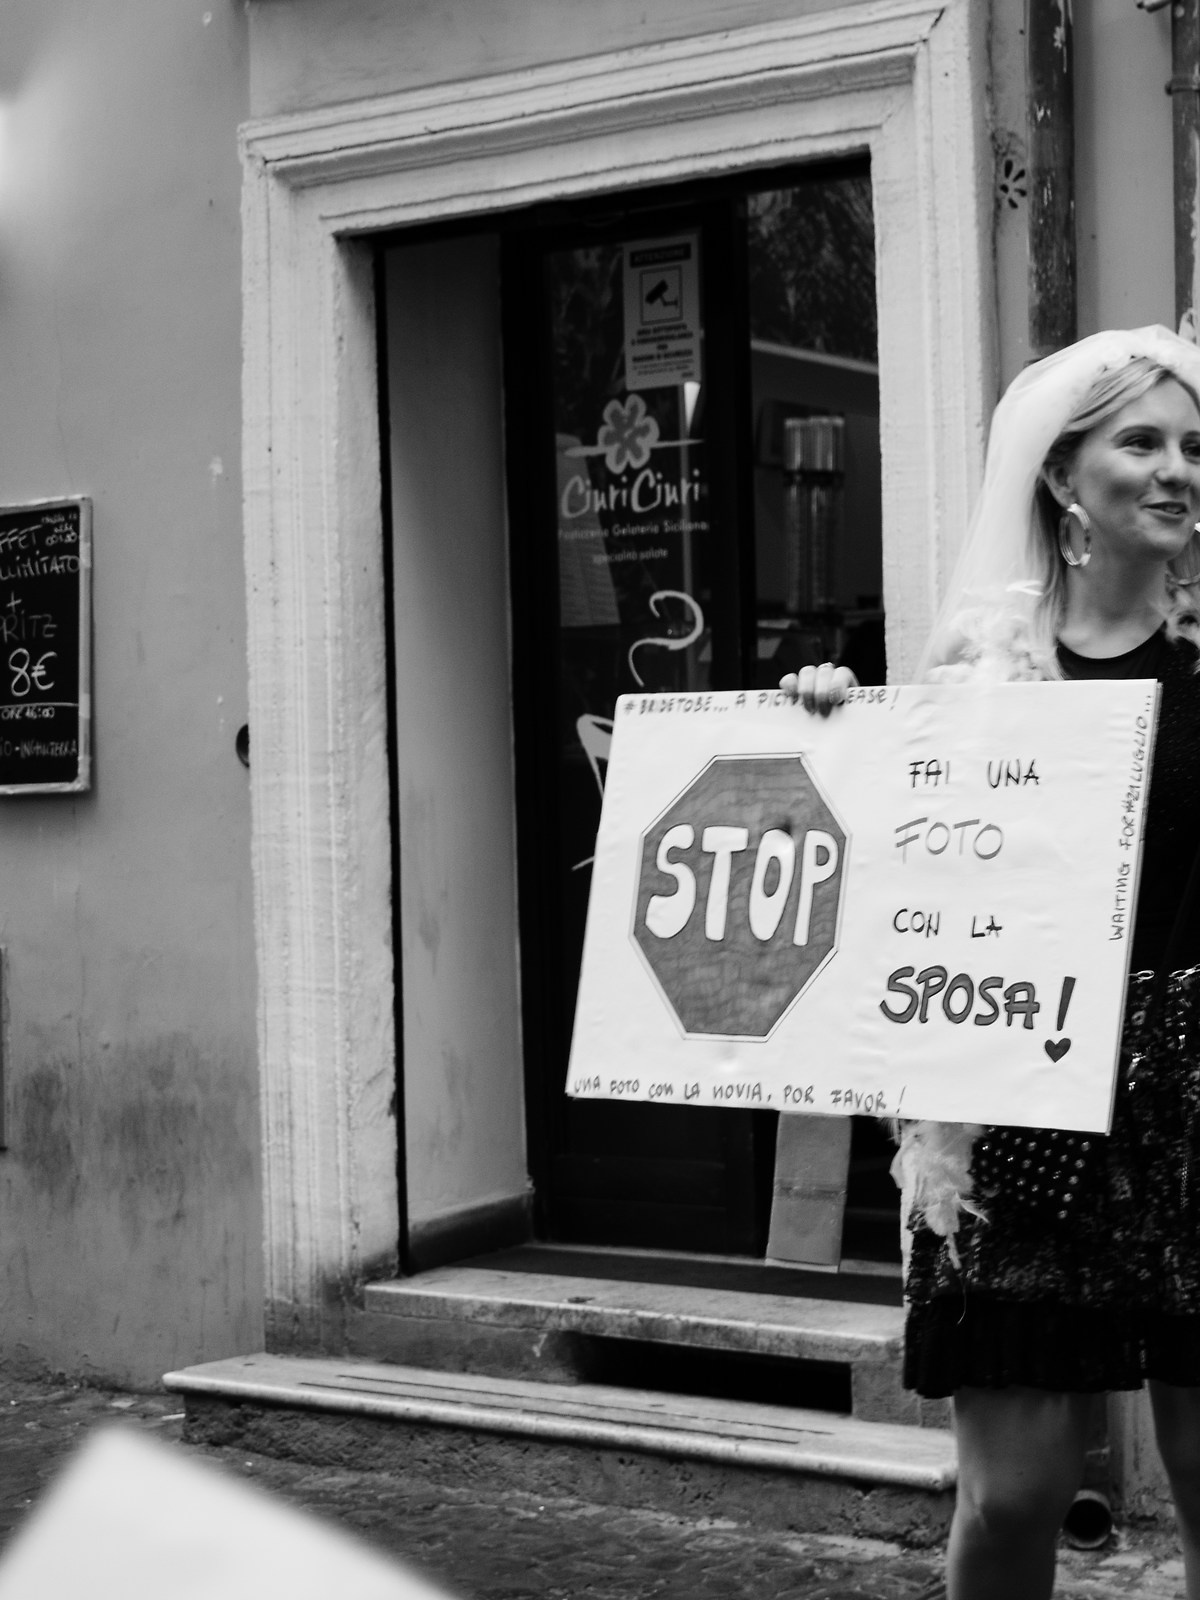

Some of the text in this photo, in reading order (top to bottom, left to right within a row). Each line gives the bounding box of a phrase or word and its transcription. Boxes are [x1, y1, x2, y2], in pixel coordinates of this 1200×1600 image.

[8, 647, 58, 697] 8€
[734, 693, 747, 707] A
[909, 758, 1040, 789] FAI UNA
[894, 816, 1004, 864] FOTO
[644, 822, 839, 947] STOP
[1108, 861, 1131, 941] WAITING
[893, 908, 1003, 938] CON LA
[574, 1075, 600, 1093] UNA
[609, 1077, 640, 1094] FOTO
[649, 1081, 673, 1099] CON
[684, 1083, 701, 1100] LA
[783, 1085, 815, 1105] POR
